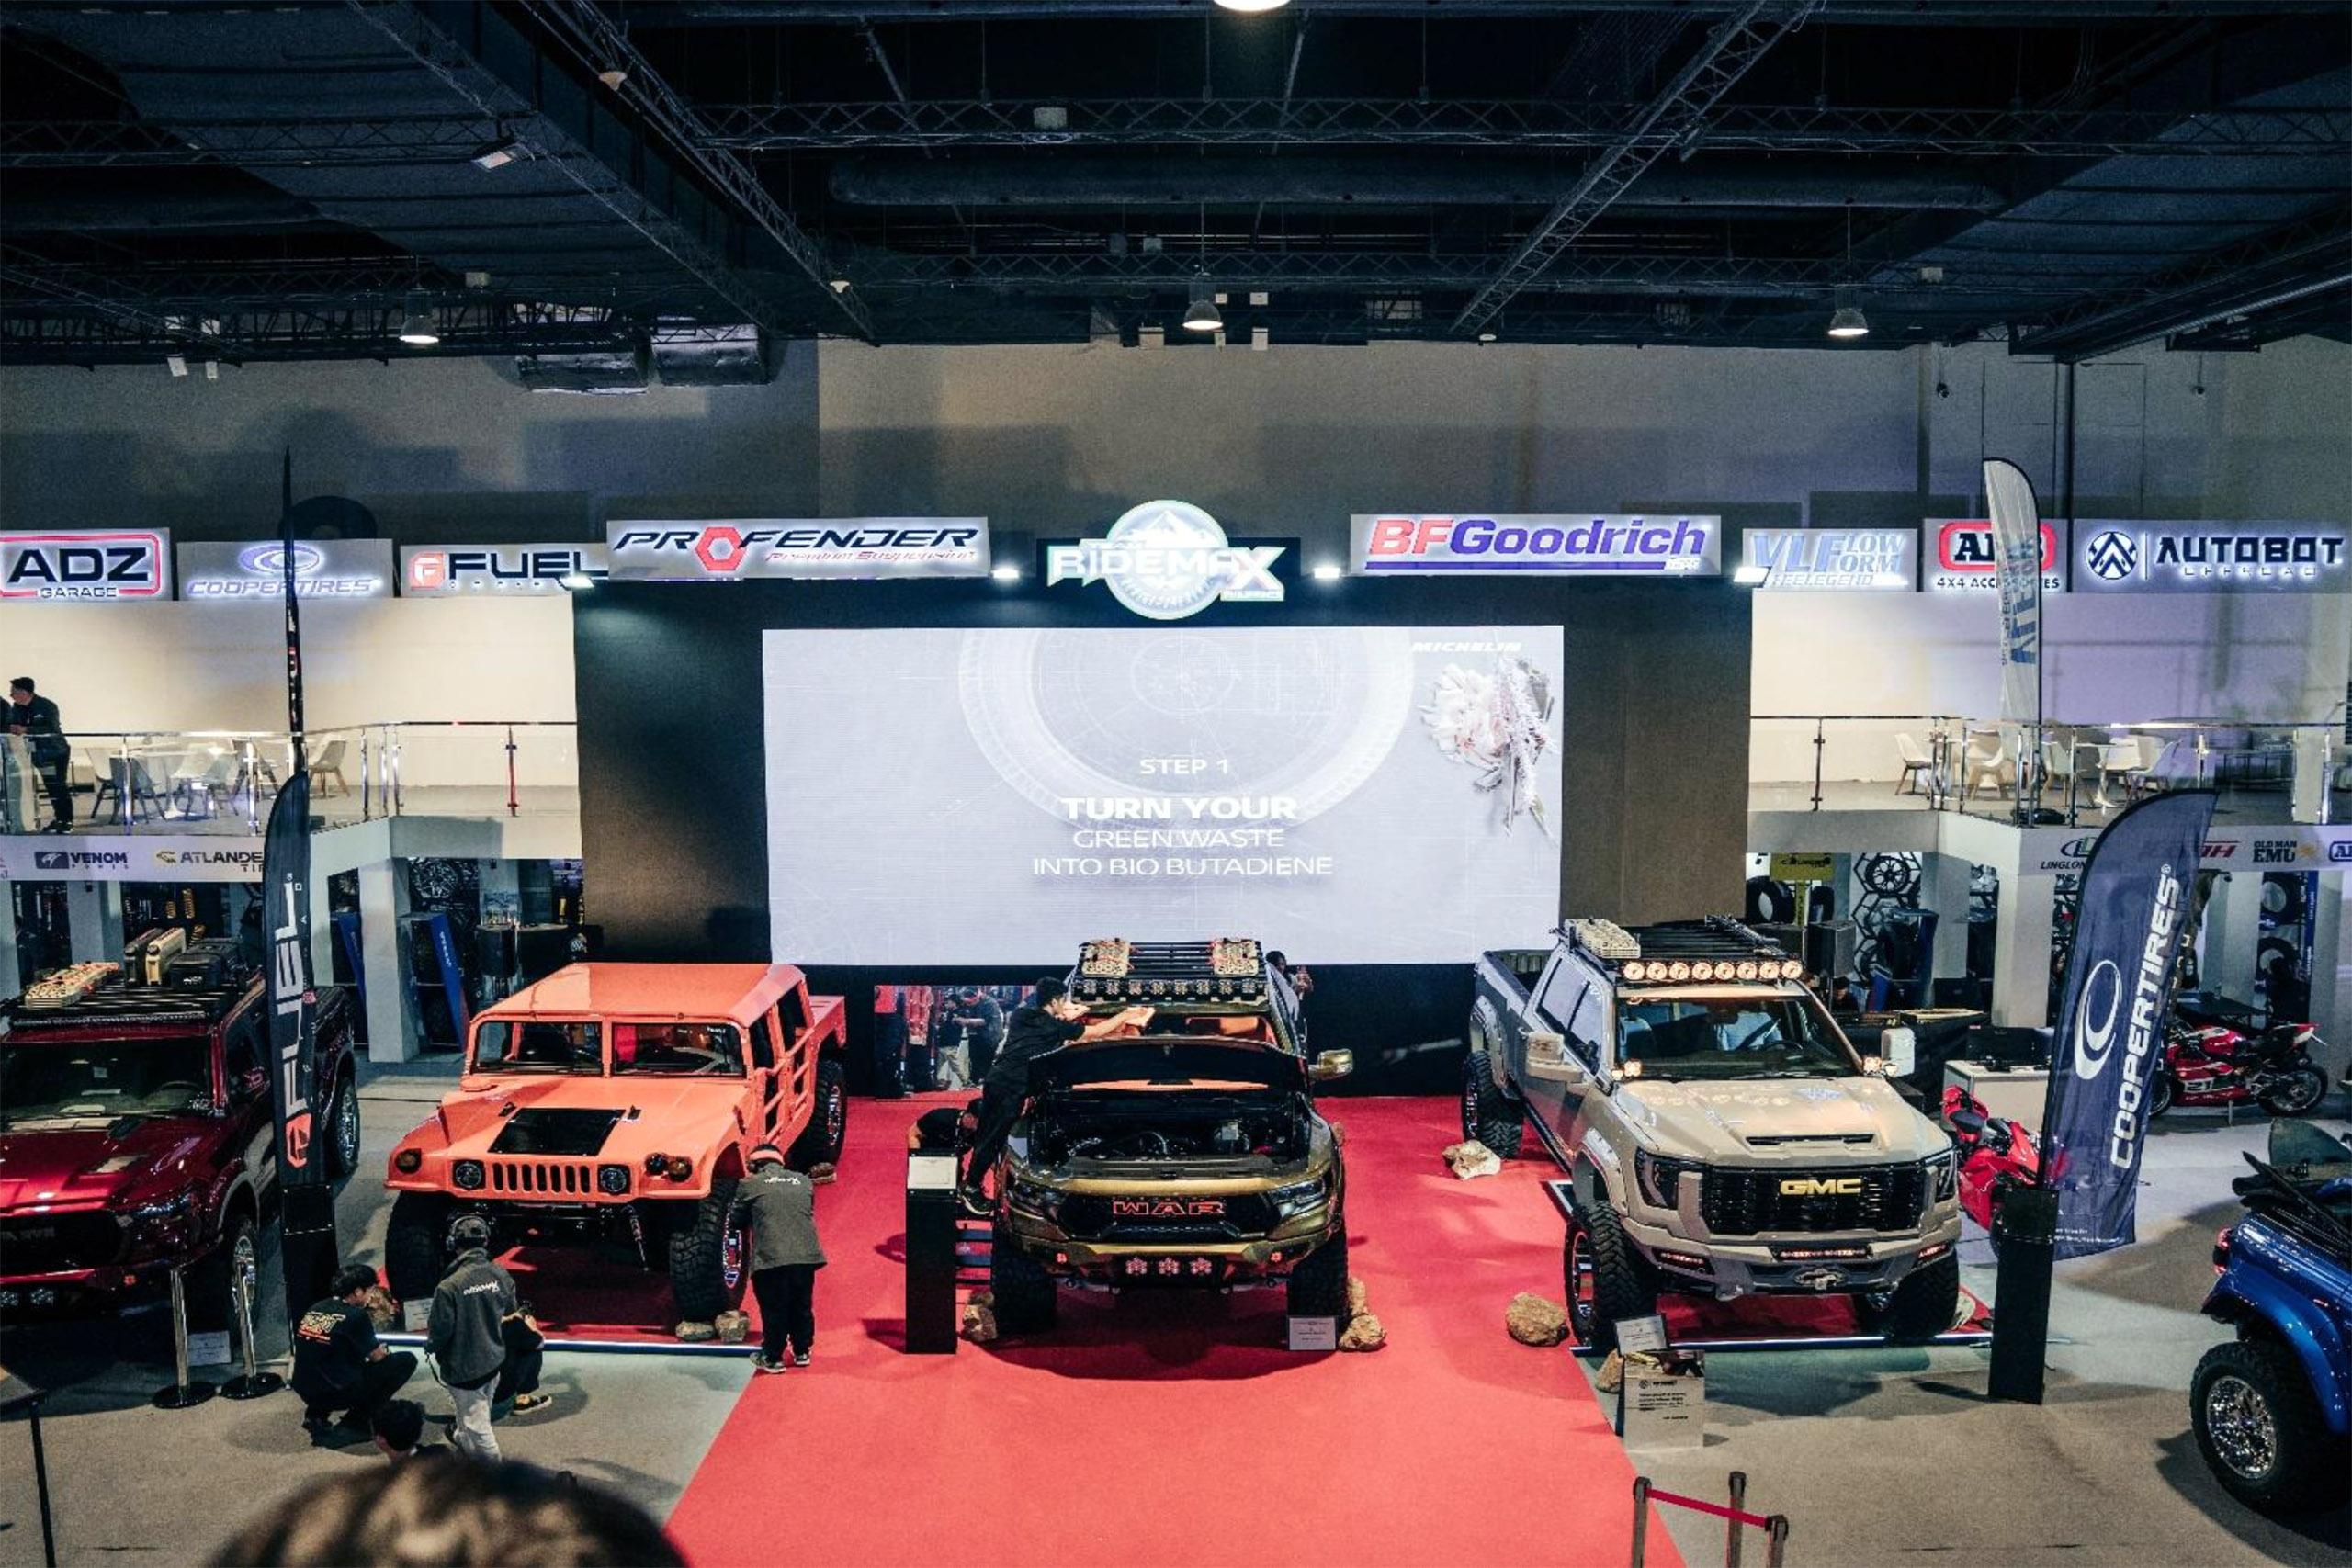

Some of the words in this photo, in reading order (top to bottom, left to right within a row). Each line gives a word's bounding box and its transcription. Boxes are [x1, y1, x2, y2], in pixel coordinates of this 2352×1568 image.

[1369, 518, 1707, 555] BFGoodrich
[2155, 536, 2345, 564] AUTOBOT
[6, 547, 149, 583] ADZ
[448, 551, 609, 580] FUEL
[1050, 546, 1286, 590] RIDEMAX
[40, 587, 118, 598] GARAGE
[1411, 641, 1522, 653] MICHELIN
[1140, 758, 1207, 774] STEP
[1217, 759, 1229, 774] 1
[1060, 797, 1172, 820] TURN
[1182, 796, 1298, 820] YOUR
[1072, 829, 1172, 848] GREEN
[1181, 829, 1285, 848] WASTE
[70, 852, 128, 863] VENOM
[2252, 848, 2296, 863] EMU
[1034, 858, 1102, 875] INTO
[1109, 858, 1159, 875] BIO
[1166, 856, 1334, 875] BUTADIENE
[2110, 874, 2181, 1170] COOPERTIRES
[1779, 1178, 1862, 1195] GMC
[1112, 1201, 1226, 1215] WAR
